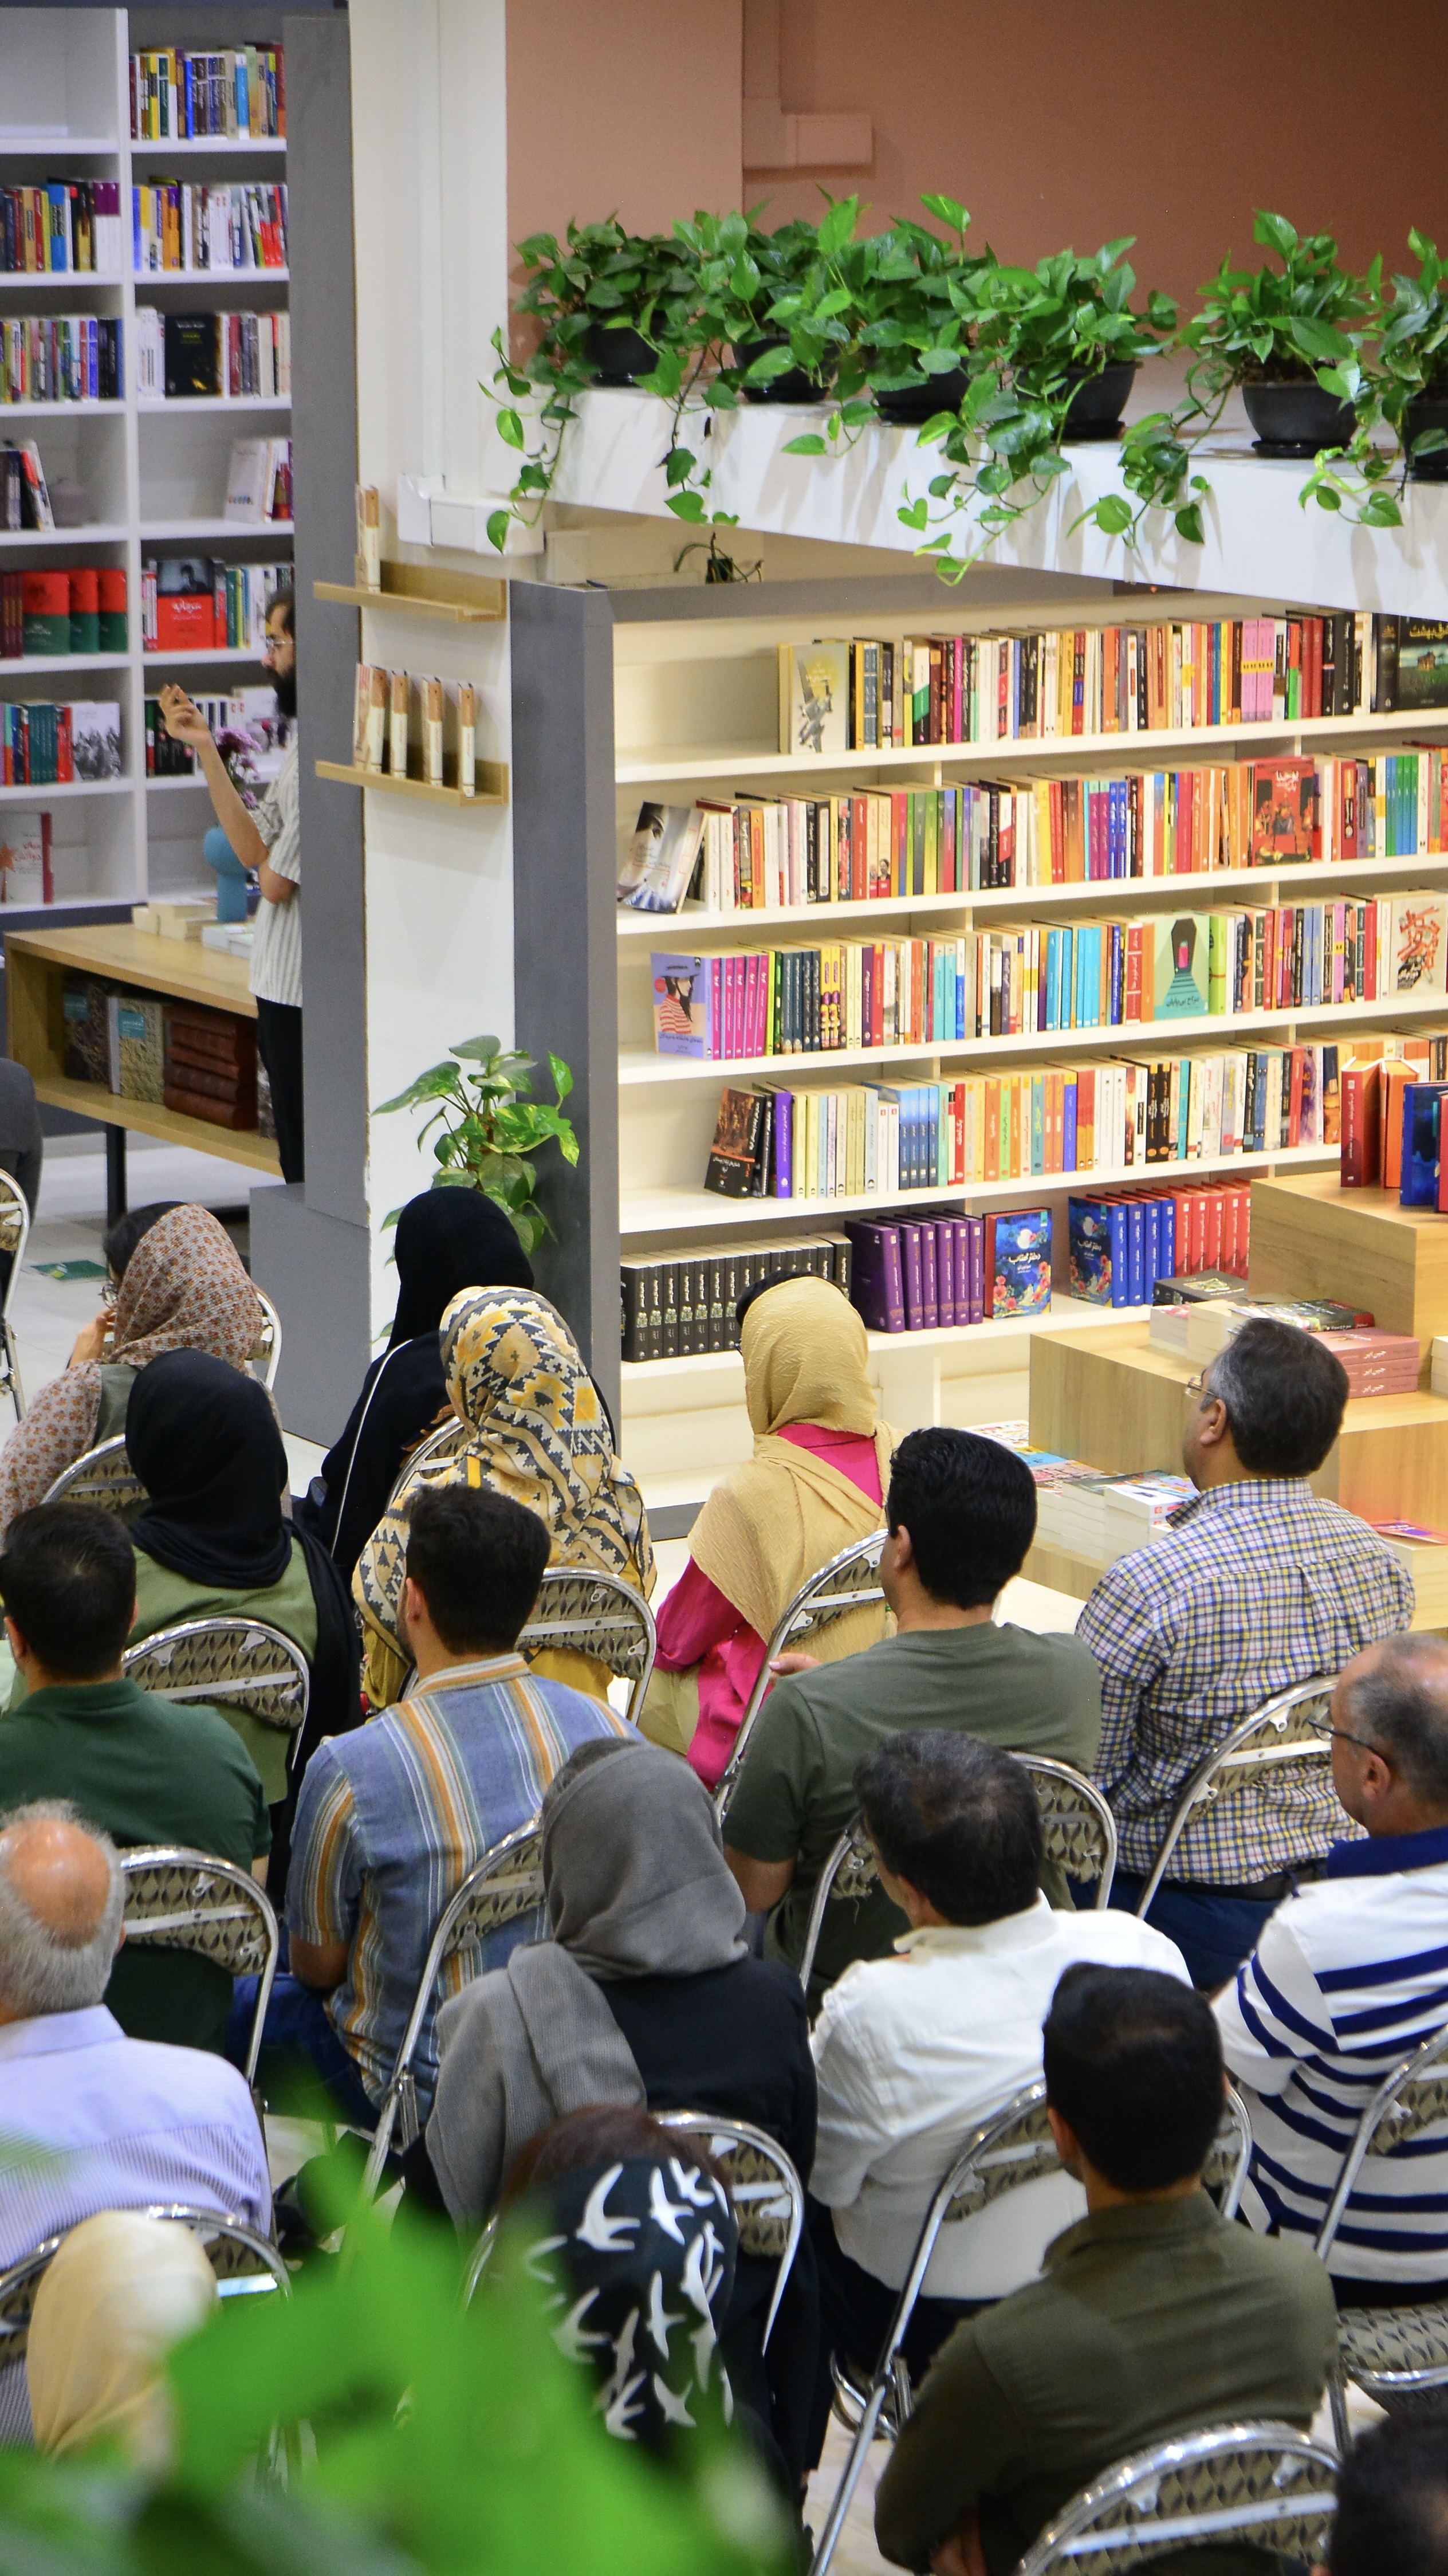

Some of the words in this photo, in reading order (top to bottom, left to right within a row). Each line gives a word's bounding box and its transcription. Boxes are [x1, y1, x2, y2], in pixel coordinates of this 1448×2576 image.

[1276, 770, 1299, 783] یوحنا
[957, 1119, 963, 1129] یک
[1092, 1242, 1102, 1252] دختر
[1028, 1252, 1041, 1263] دختر
[1364, 1351, 1374, 1360] ایر
[1372, 1350, 1387, 1359] جین
[1363, 1368, 1372, 1376] ایر
[1372, 1367, 1386, 1376] جین
[1362, 1385, 1371, 1393] ایر
[1371, 1384, 1384, 1393] جین
